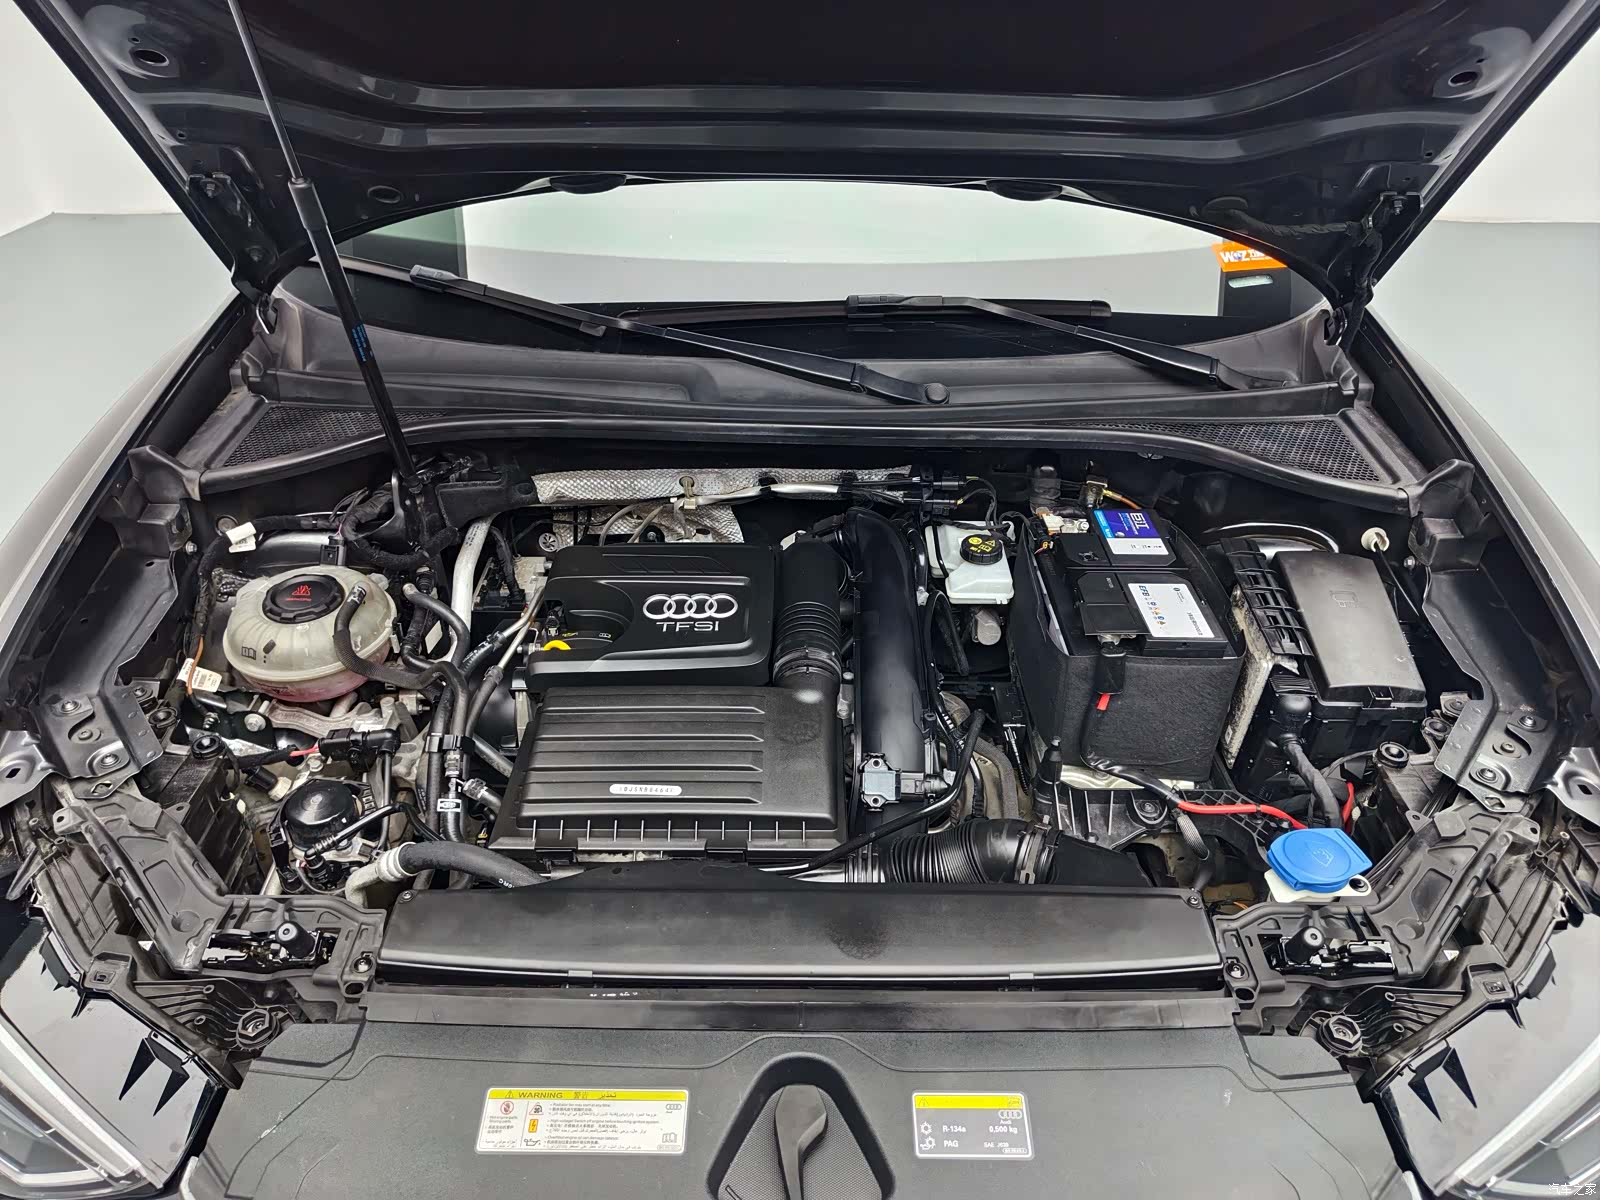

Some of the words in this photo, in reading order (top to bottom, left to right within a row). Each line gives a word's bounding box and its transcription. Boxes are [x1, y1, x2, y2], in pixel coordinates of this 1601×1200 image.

[656, 621, 719, 632] TFSI
[942, 1125, 967, 1133] R-134a
[989, 1125, 1008, 1133] 0,500
[1009, 1125, 1018, 1134] kg
[943, 1140, 959, 1148] PAG
